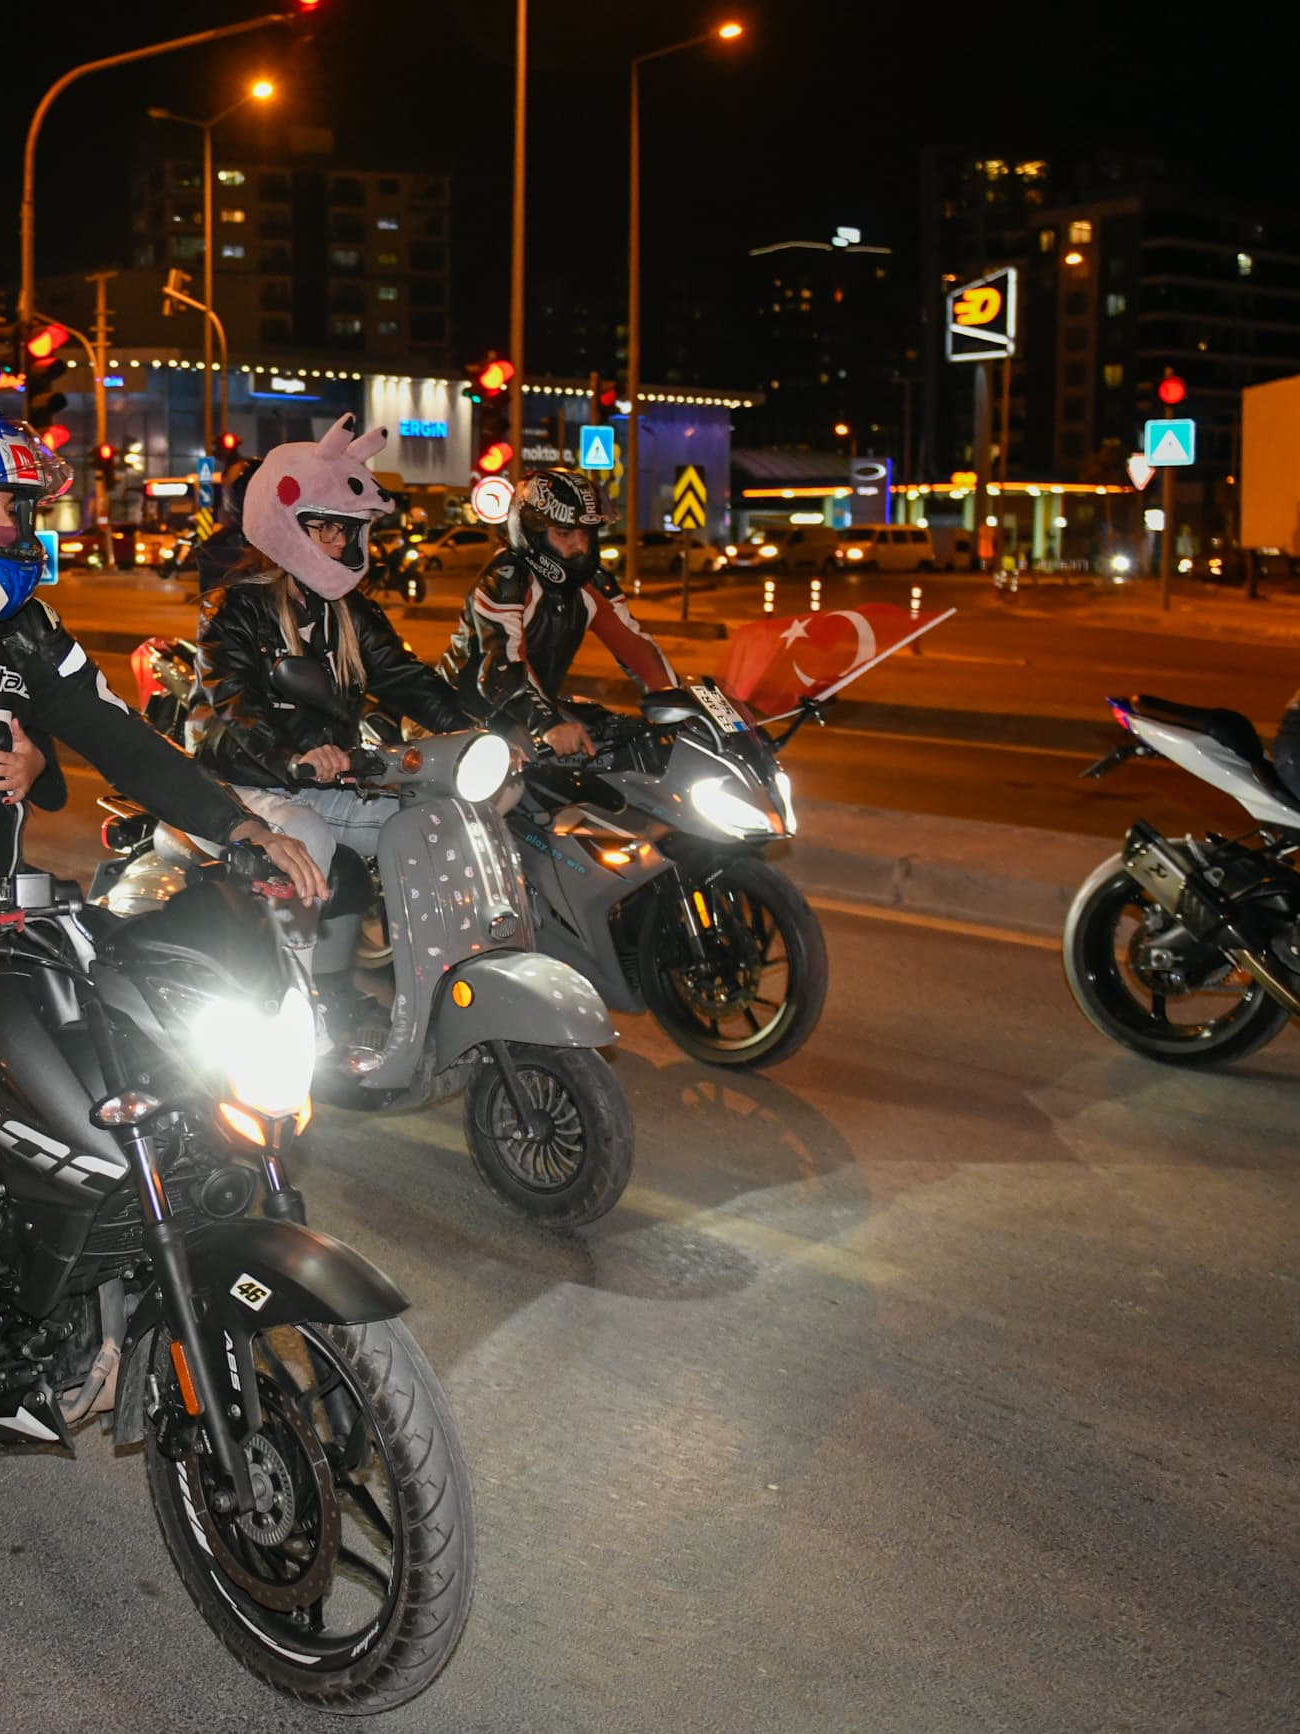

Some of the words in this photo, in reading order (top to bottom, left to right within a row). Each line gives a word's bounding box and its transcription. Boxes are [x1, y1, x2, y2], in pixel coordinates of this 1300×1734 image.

[525, 834, 548, 851] play
[552, 848, 563, 860] to
[567, 859, 586, 873] win
[237, 1282, 267, 1303] 46
[223, 1329, 241, 1392] ABS
